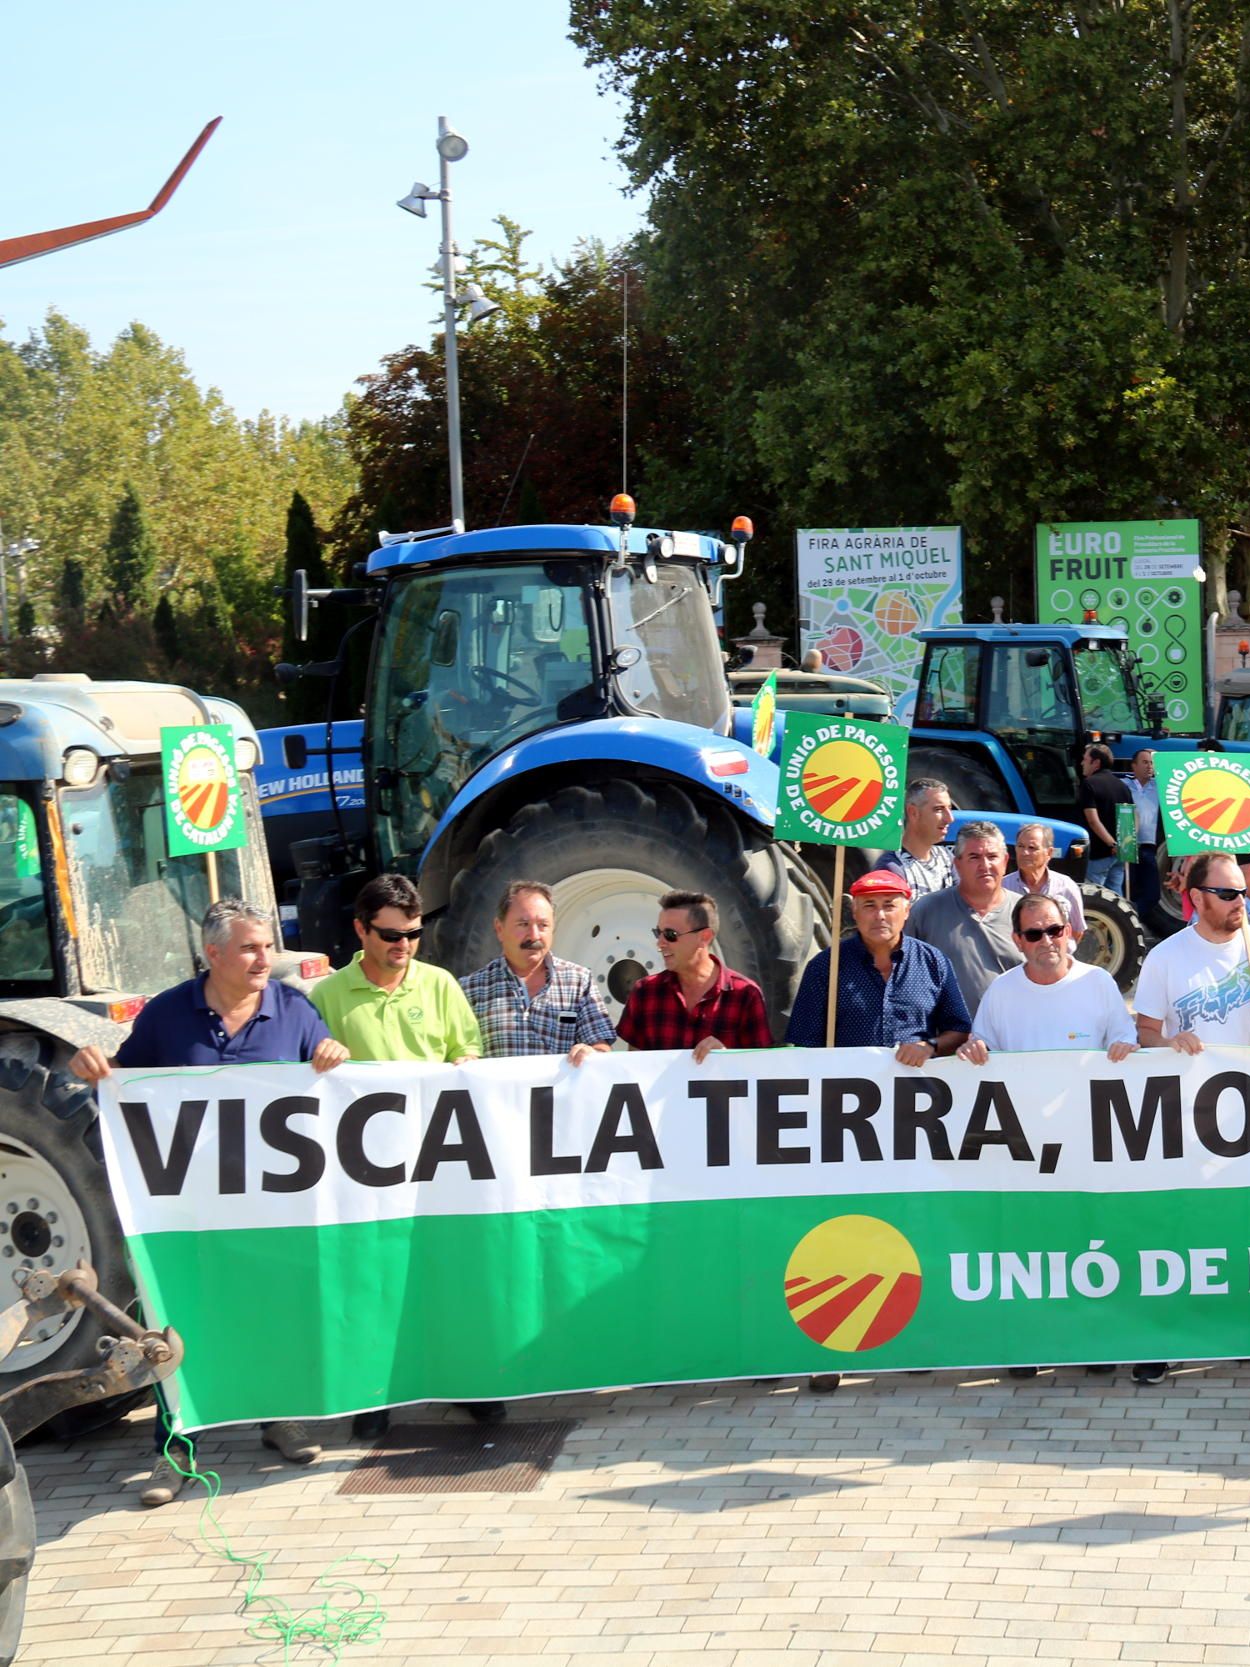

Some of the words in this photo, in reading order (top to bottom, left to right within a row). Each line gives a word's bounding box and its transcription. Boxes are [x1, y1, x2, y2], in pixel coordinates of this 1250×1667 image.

[808, 538, 840, 550] FIRA
[844, 534, 905, 550] AGRÀRIA
[910, 536, 928, 548] DE
[1049, 531, 1121, 555] EURO
[824, 553, 873, 573] SANT
[880, 547, 951, 570] MIQUEL
[1050, 557, 1128, 581] FRUIT
[807, 579, 821, 588] del
[822, 578, 833, 587] 28
[835, 577, 846, 586] de
[848, 574, 887, 586] setembre
[888, 573, 896, 582] al
[898, 573, 904, 581] 1
[785, 735, 817, 779] UNIÓ
[816, 725, 842, 742] DE
[844, 725, 899, 789] PAGESOS
[1165, 768, 1187, 805] UNIÓ
[1184, 758, 1208, 773] DE
[785, 784, 806, 811] DE
[800, 795, 898, 839] CATALUNYA
[1168, 808, 1191, 831] DE
[118, 1089, 496, 1196] VISCA
[529, 1083, 664, 1176] LA
[687, 1076, 1063, 1174] TERRA,
[949, 1239, 1120, 1301] UNIÓ
[1138, 1248, 1229, 1297] DE
